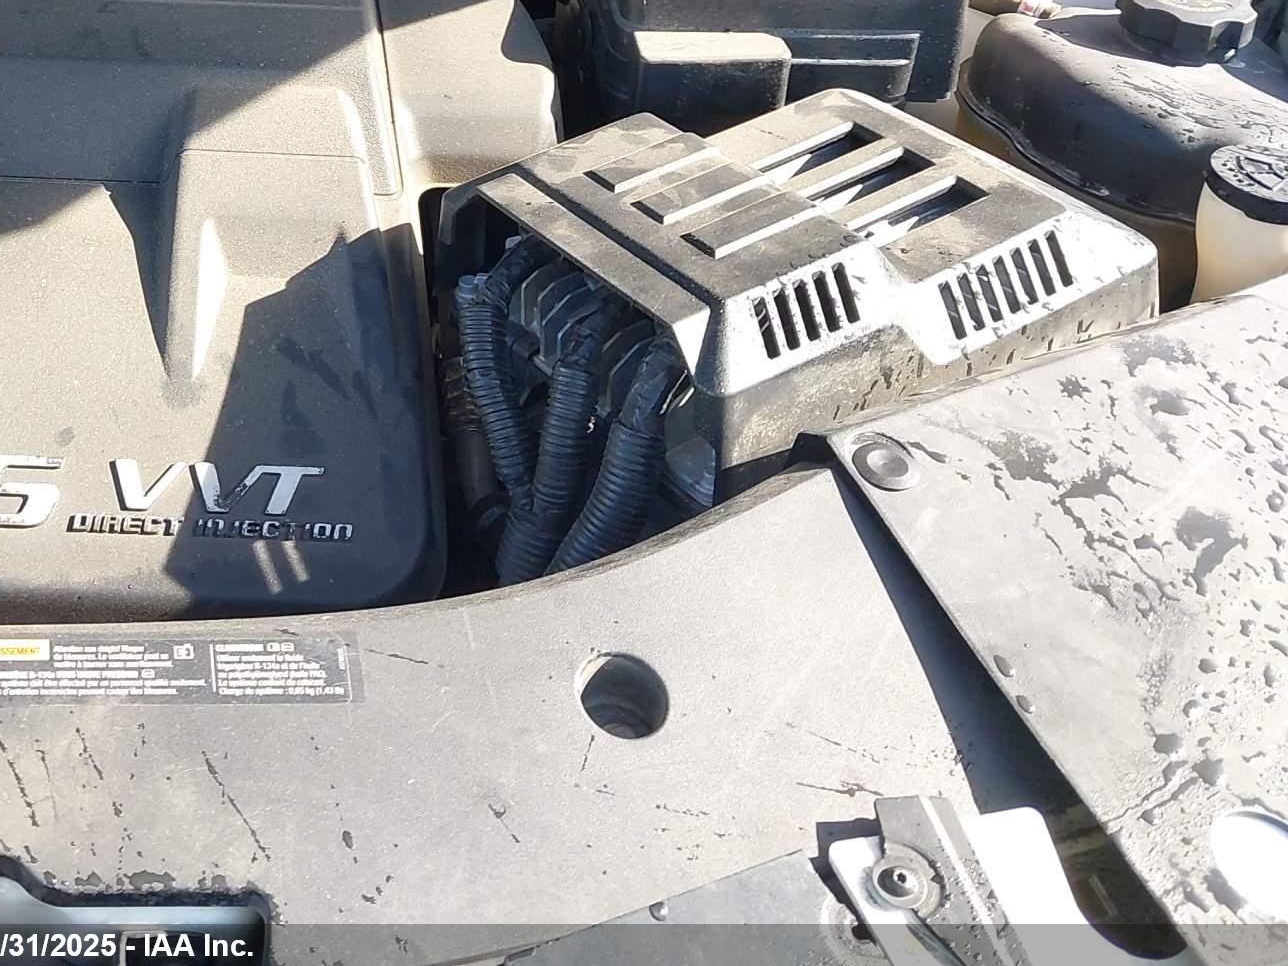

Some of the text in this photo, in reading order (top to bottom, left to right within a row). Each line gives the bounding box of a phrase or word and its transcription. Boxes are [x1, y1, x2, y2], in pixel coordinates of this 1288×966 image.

[109, 458, 325, 515] VVT
[66, 513, 353, 541] DIRECT INJECTION
